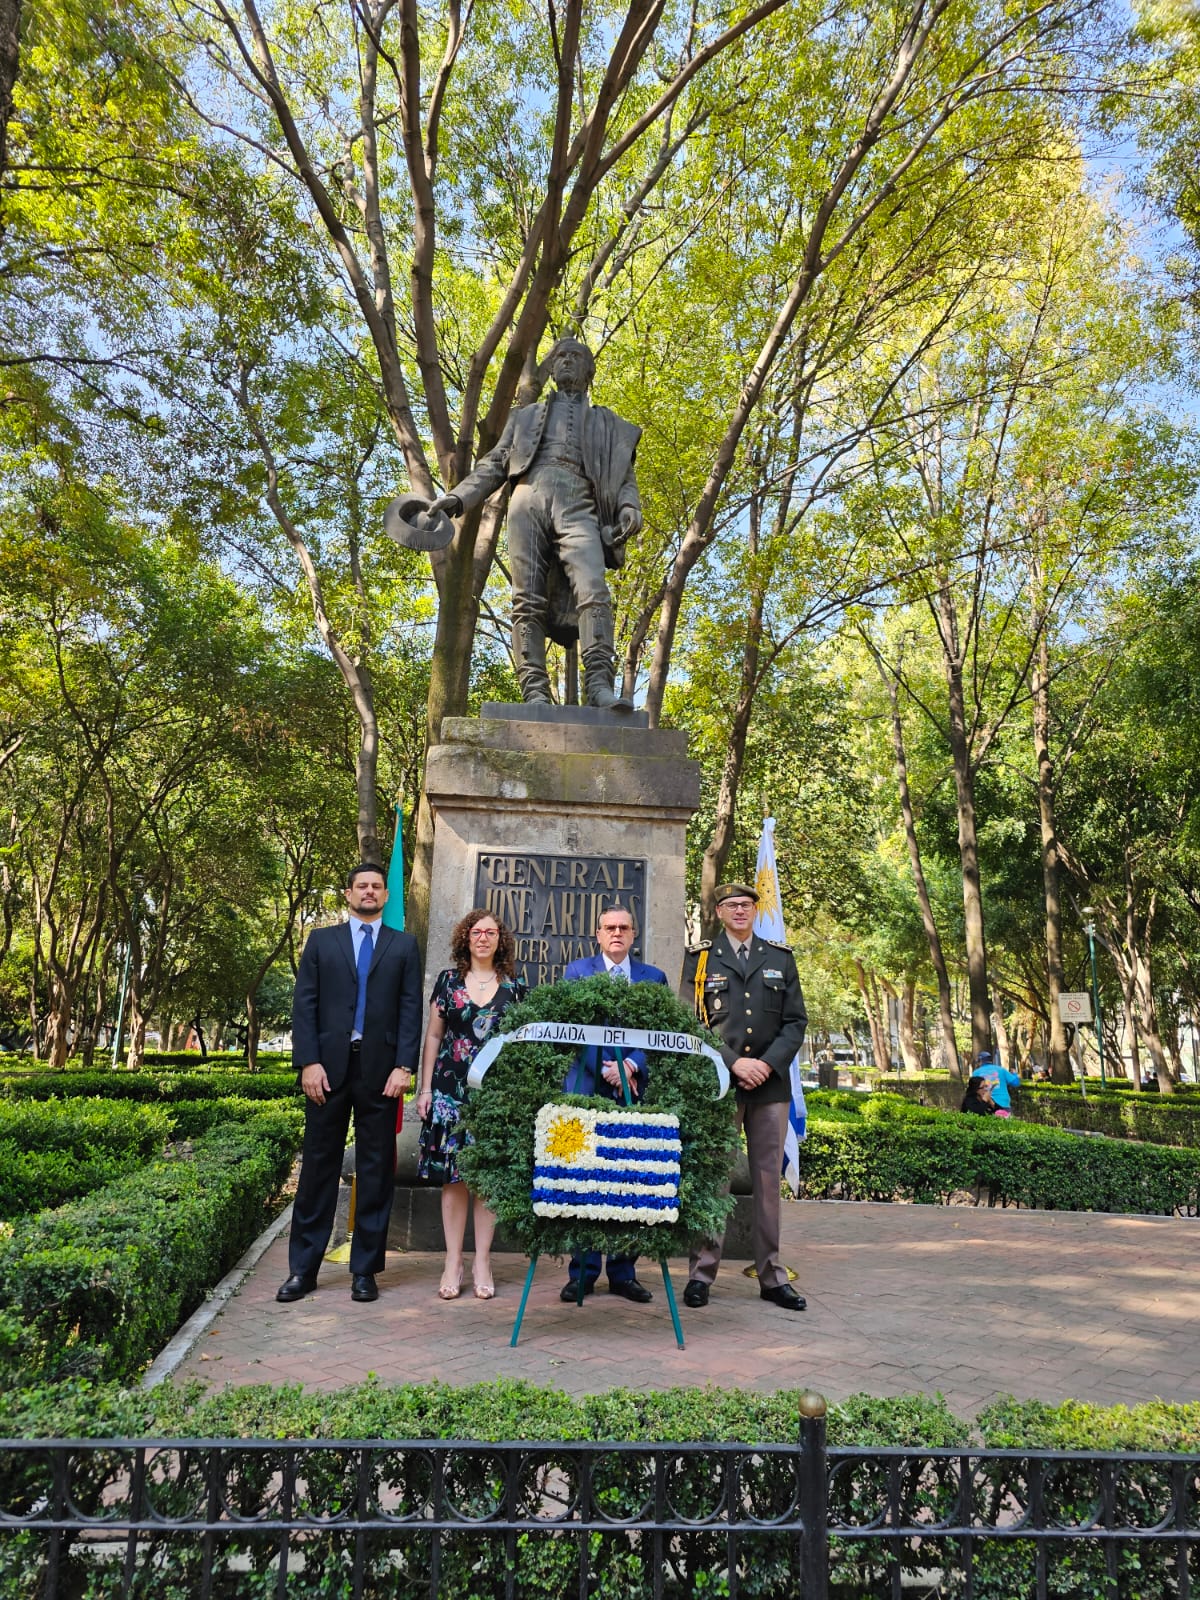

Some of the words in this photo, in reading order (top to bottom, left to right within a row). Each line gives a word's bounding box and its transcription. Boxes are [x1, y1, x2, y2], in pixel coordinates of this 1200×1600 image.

[487, 857, 634, 890] GENERAL
[515, 1025, 586, 1042] EMBAJADA
[603, 1029, 630, 1045] DEL
[647, 1033, 703, 1053] URUGUAY
